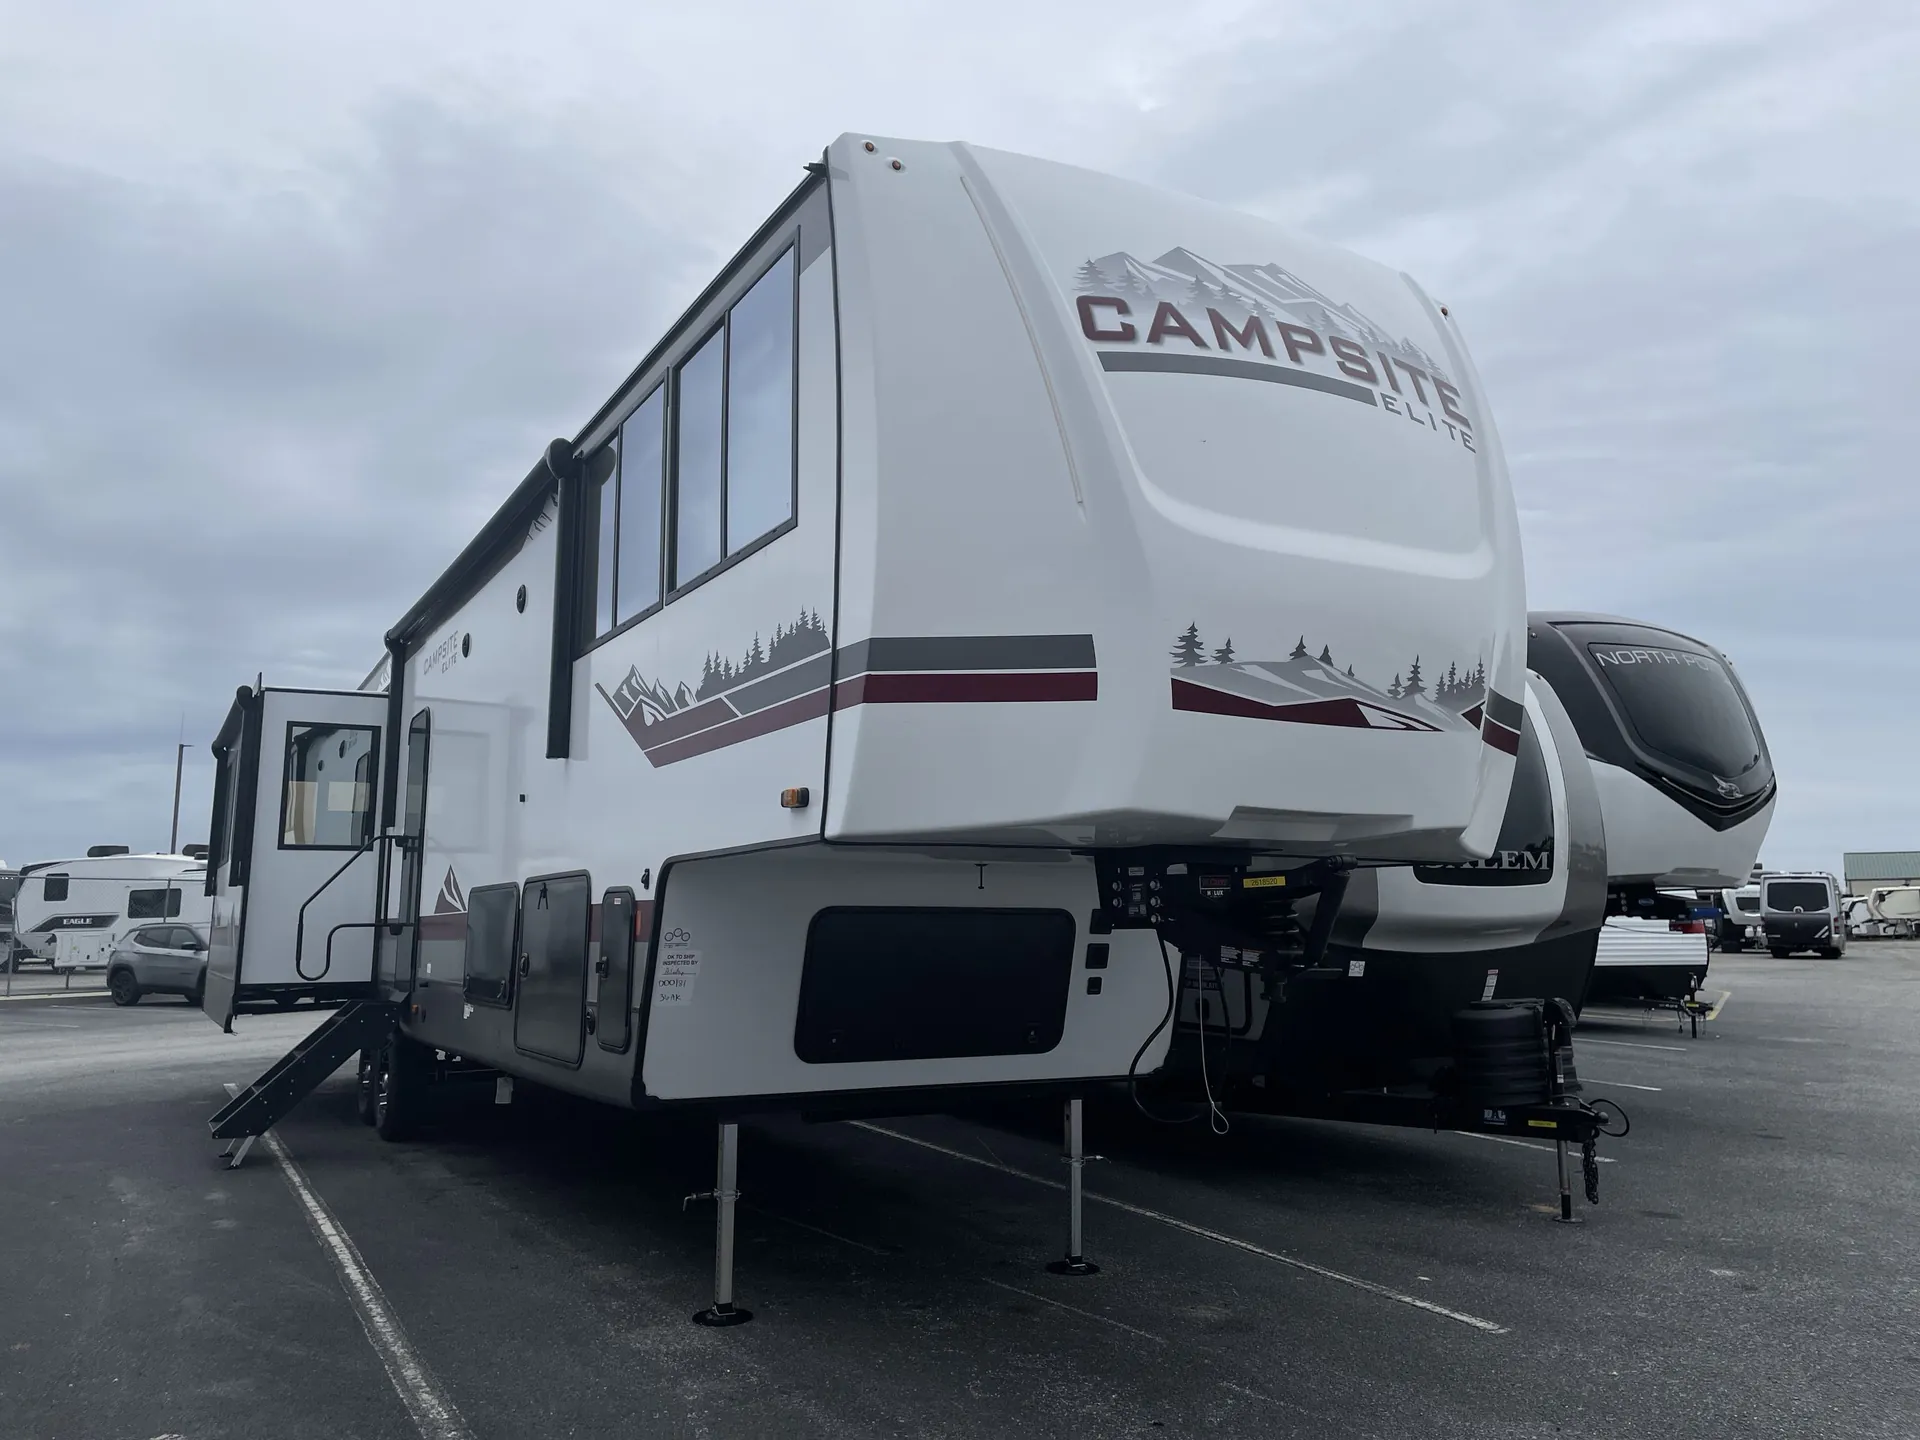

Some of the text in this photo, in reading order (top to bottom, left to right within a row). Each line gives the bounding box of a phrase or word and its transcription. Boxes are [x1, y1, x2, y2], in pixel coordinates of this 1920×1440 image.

[1076, 294, 1473, 432] CAMPSITE
[1379, 391, 1477, 454] ELITE
[423, 630, 459, 675] CAMPSITE
[441, 652, 458, 674] ELITE
[1595, 650, 1680, 667] NORTH
[63, 917, 93, 925] EAGLE
